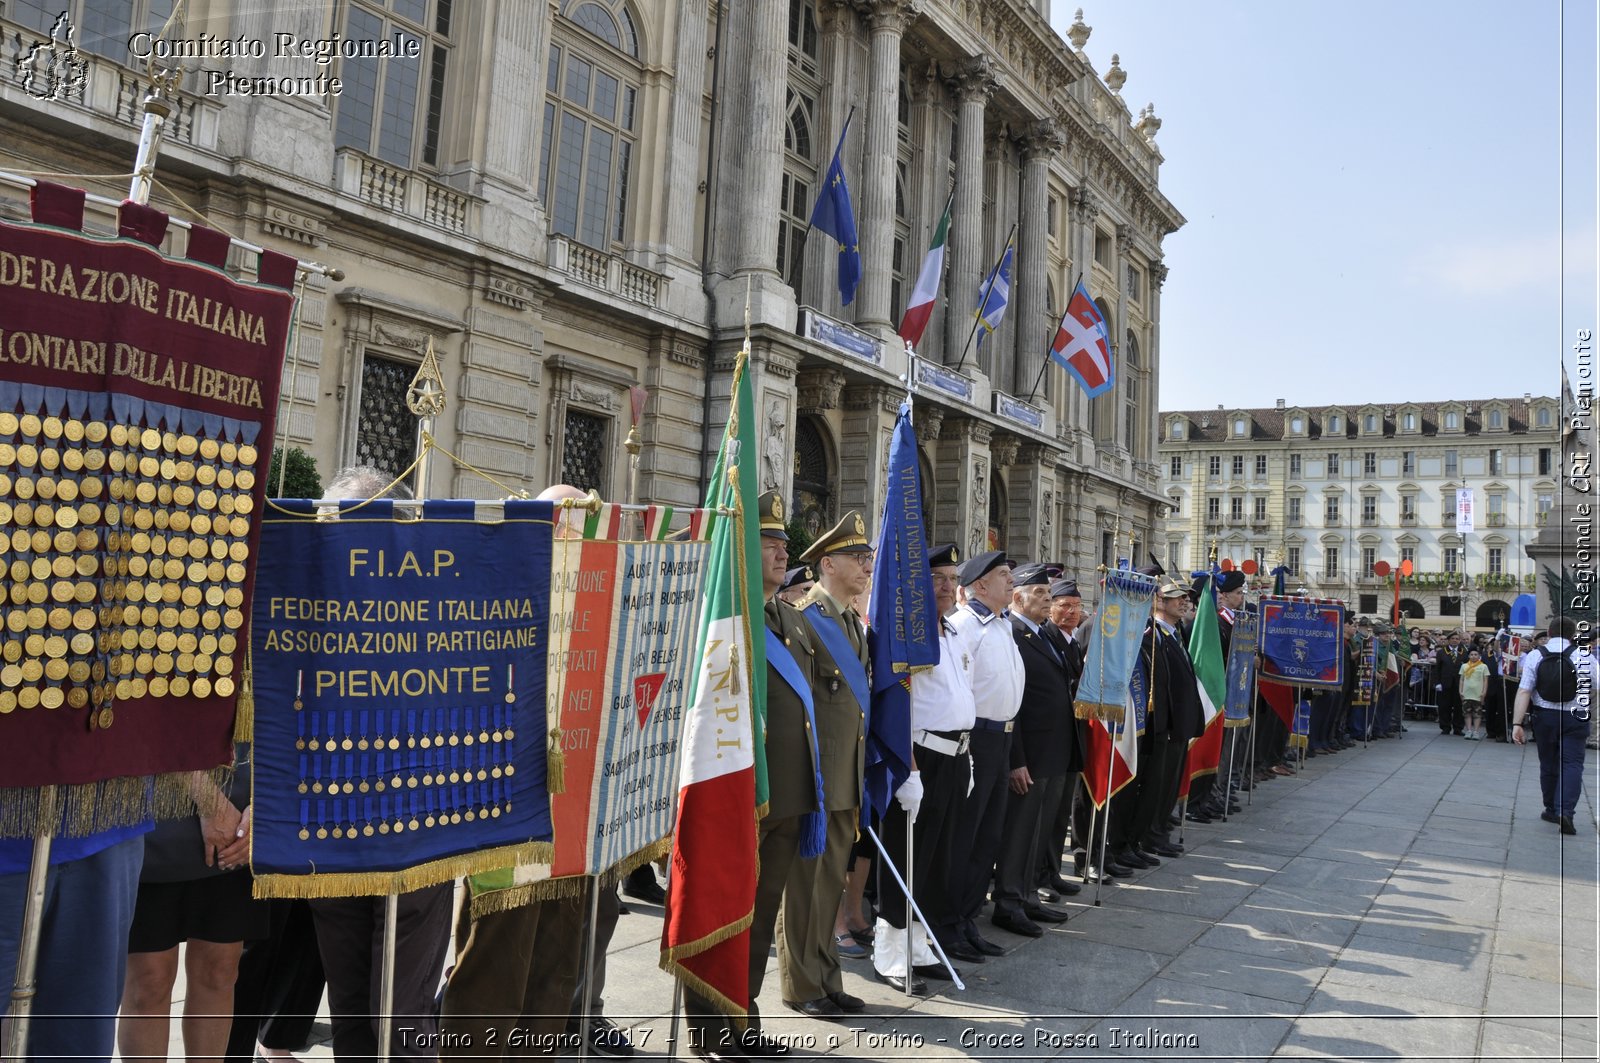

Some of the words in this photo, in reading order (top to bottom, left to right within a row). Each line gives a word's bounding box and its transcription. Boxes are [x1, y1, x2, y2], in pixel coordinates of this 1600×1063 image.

[165, 288, 268, 347] ITALIANA
[349, 549, 461, 578] F.I.A.P.
[906, 525, 924, 578] MARINAI
[270, 597, 430, 623] FEDERAZIONE
[438, 599, 534, 622] ITALIANA
[264, 629, 418, 655] ASSOCIAZIONI
[427, 626, 538, 653] PARTIGIANE
[316, 666, 491, 698] PIEMONTE
[1284, 666, 1318, 677] TORINO
[567, 688, 593, 712] NEI
[648, 796, 671, 814] SABBA
